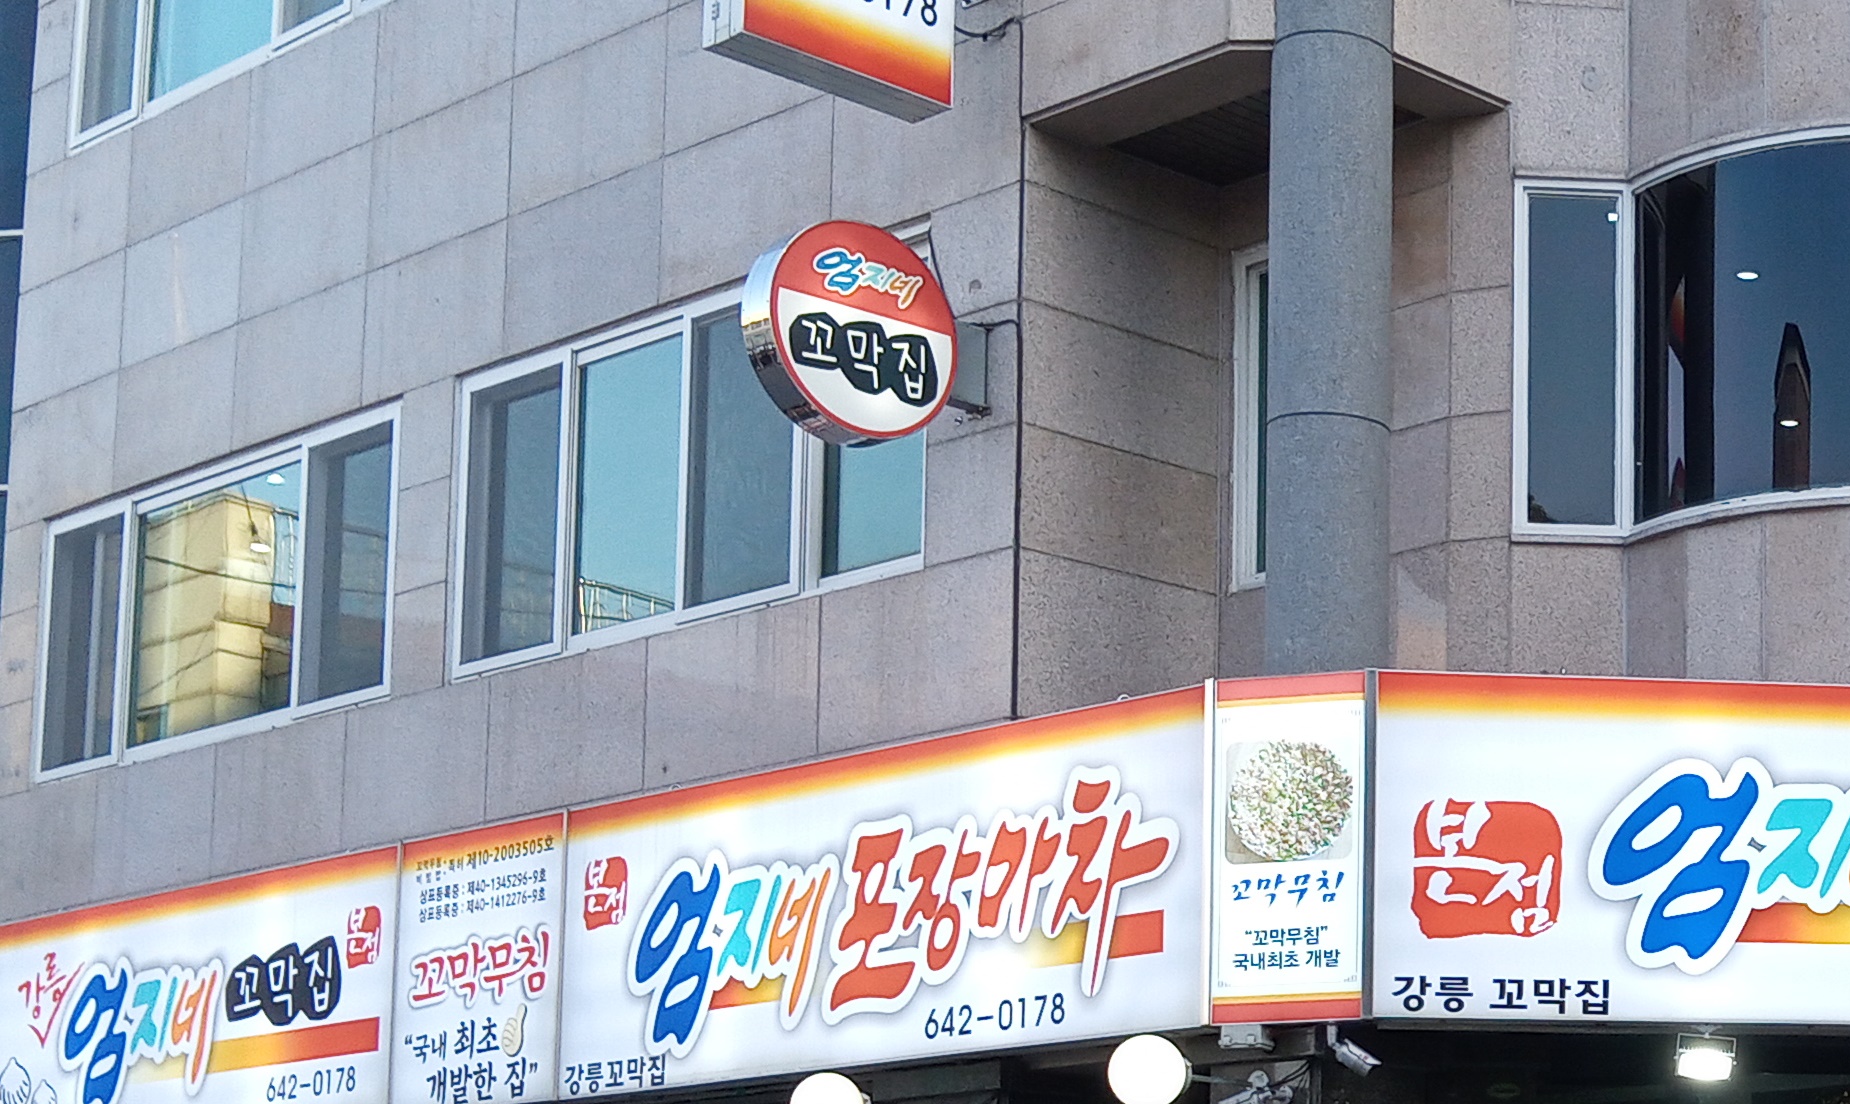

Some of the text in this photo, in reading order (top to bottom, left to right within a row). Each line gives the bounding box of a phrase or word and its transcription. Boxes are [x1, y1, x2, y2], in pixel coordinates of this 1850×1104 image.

[815, 249, 923, 307] 엄지네
[801, 319, 927, 400] 꼬막집
[584, 856, 628, 931] 본점
[1231, 869, 1345, 908] 꼬막무침
[1411, 798, 1563, 939] 본점
[347, 906, 382, 968] 본점
[635, 778, 1170, 1045] 엄지네 포장마차
[233, 951, 336, 1016] 꼬막집
[411, 930, 550, 1004] 꼬막무침
[1232, 947, 1341, 971] 국내최초 개발
[924, 993, 1066, 1040] 642-0178
[1391, 975, 1612, 1016] 강릉 꼬막집
[453, 1021, 501, 1057] 최초
[266, 1066, 357, 1103] 642-0178
